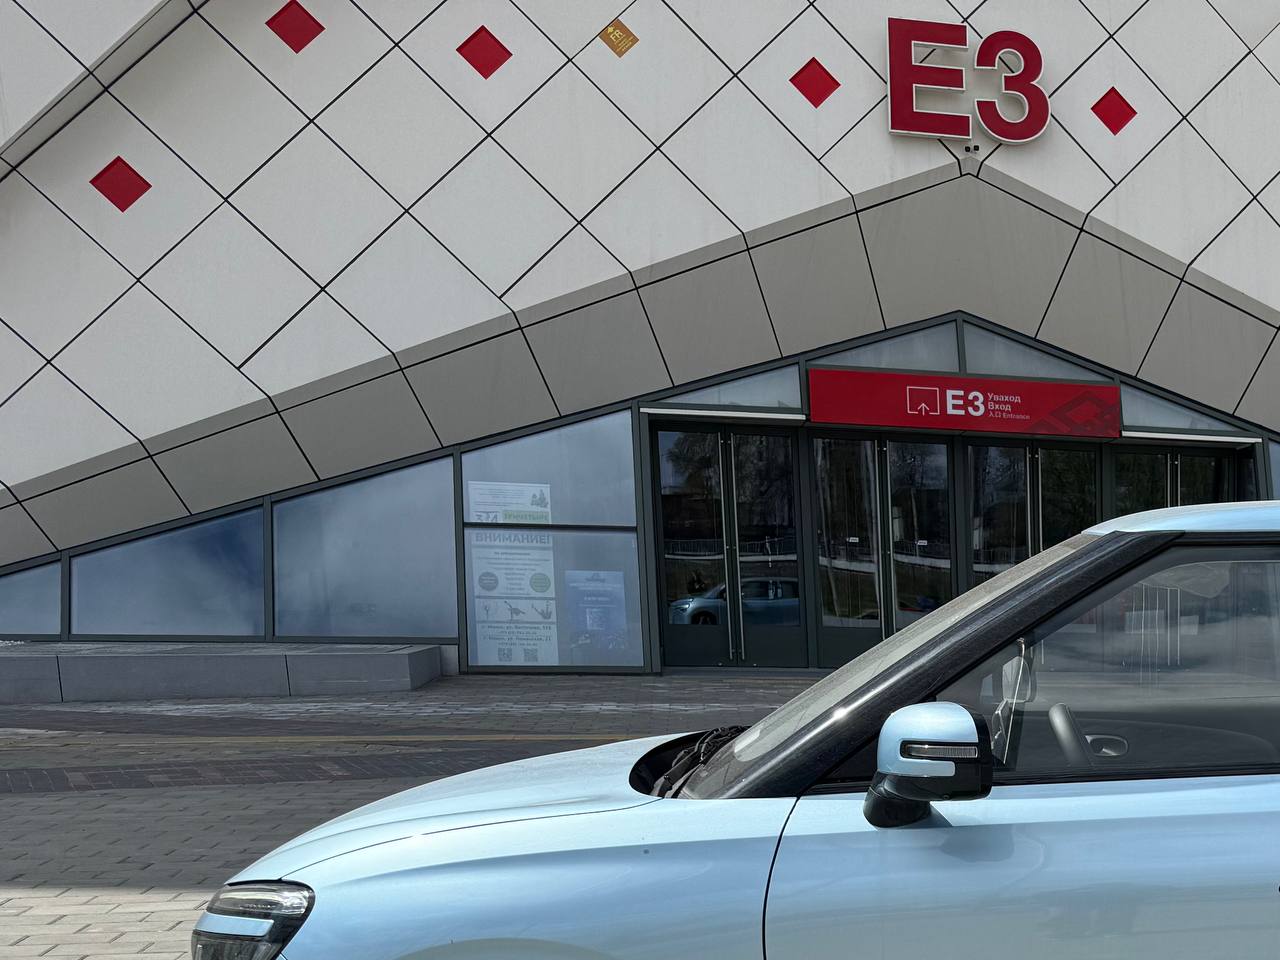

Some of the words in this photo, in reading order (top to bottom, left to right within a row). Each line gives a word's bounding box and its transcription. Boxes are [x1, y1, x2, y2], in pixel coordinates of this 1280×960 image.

[887, 17, 1051, 144] E3
[946, 389, 985, 417] E3
[987, 401, 1012, 412] Вход
[475, 532, 550, 544] ВНИМАНИЕ!
